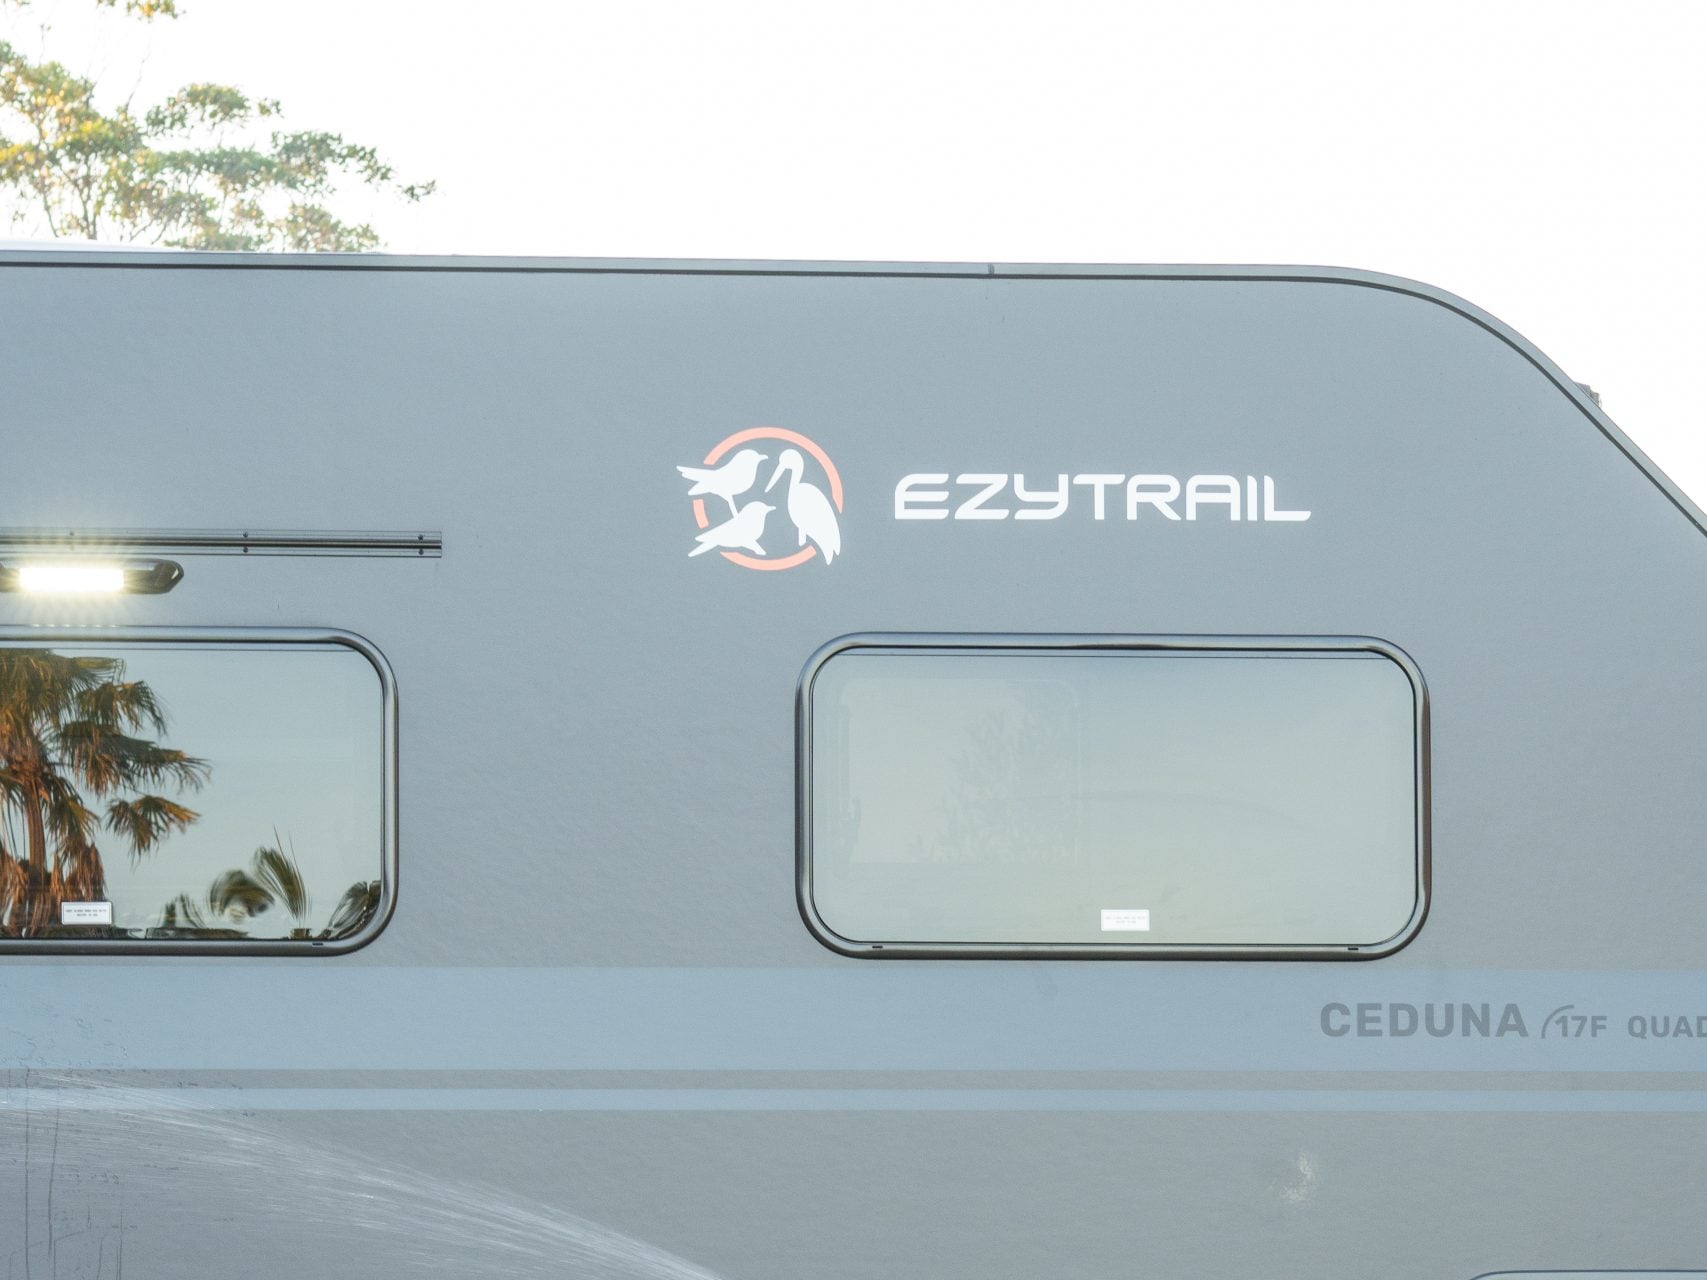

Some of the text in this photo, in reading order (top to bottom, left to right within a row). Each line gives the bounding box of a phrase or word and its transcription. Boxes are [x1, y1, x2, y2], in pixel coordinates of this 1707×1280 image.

[895, 473, 1311, 521] EZYTRAIL
[1320, 1002, 1528, 1038] CEDUNA
[1555, 1015, 1607, 1038] 17F
